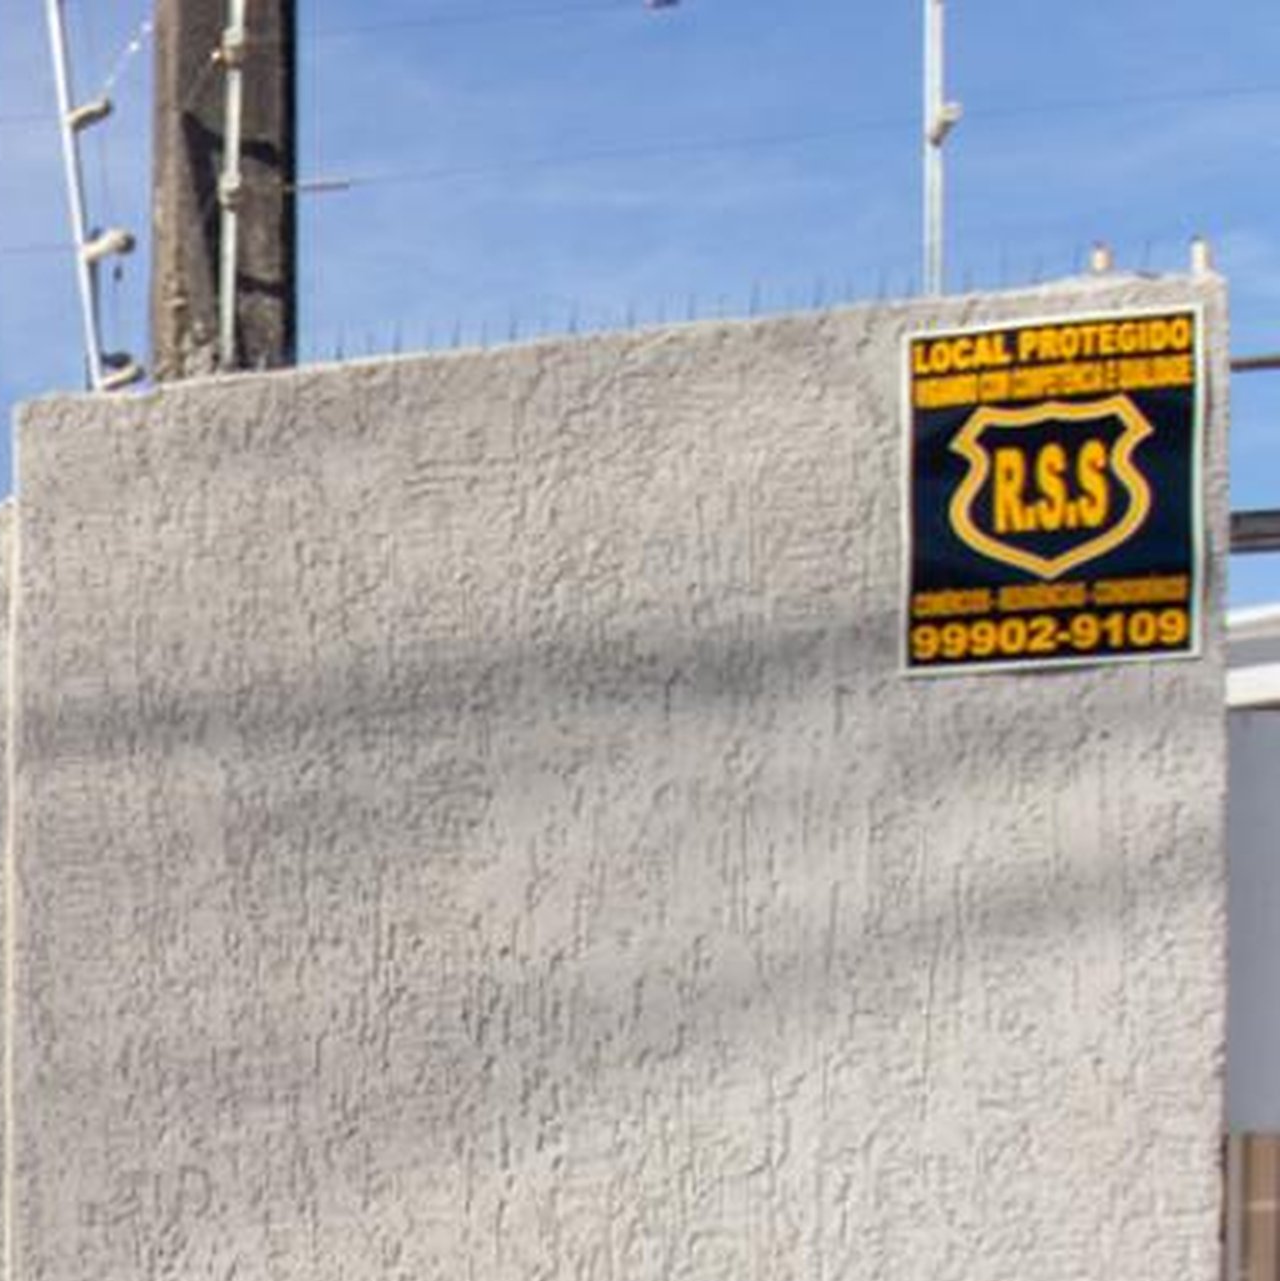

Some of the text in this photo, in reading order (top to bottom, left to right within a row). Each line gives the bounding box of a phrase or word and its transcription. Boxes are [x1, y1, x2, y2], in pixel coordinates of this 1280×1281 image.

[914, 317, 1191, 374] LOCAL PROTEGIDO
[993, 438, 1110, 534] R.S.S
[911, 608, 1189, 661] 99902-9109
